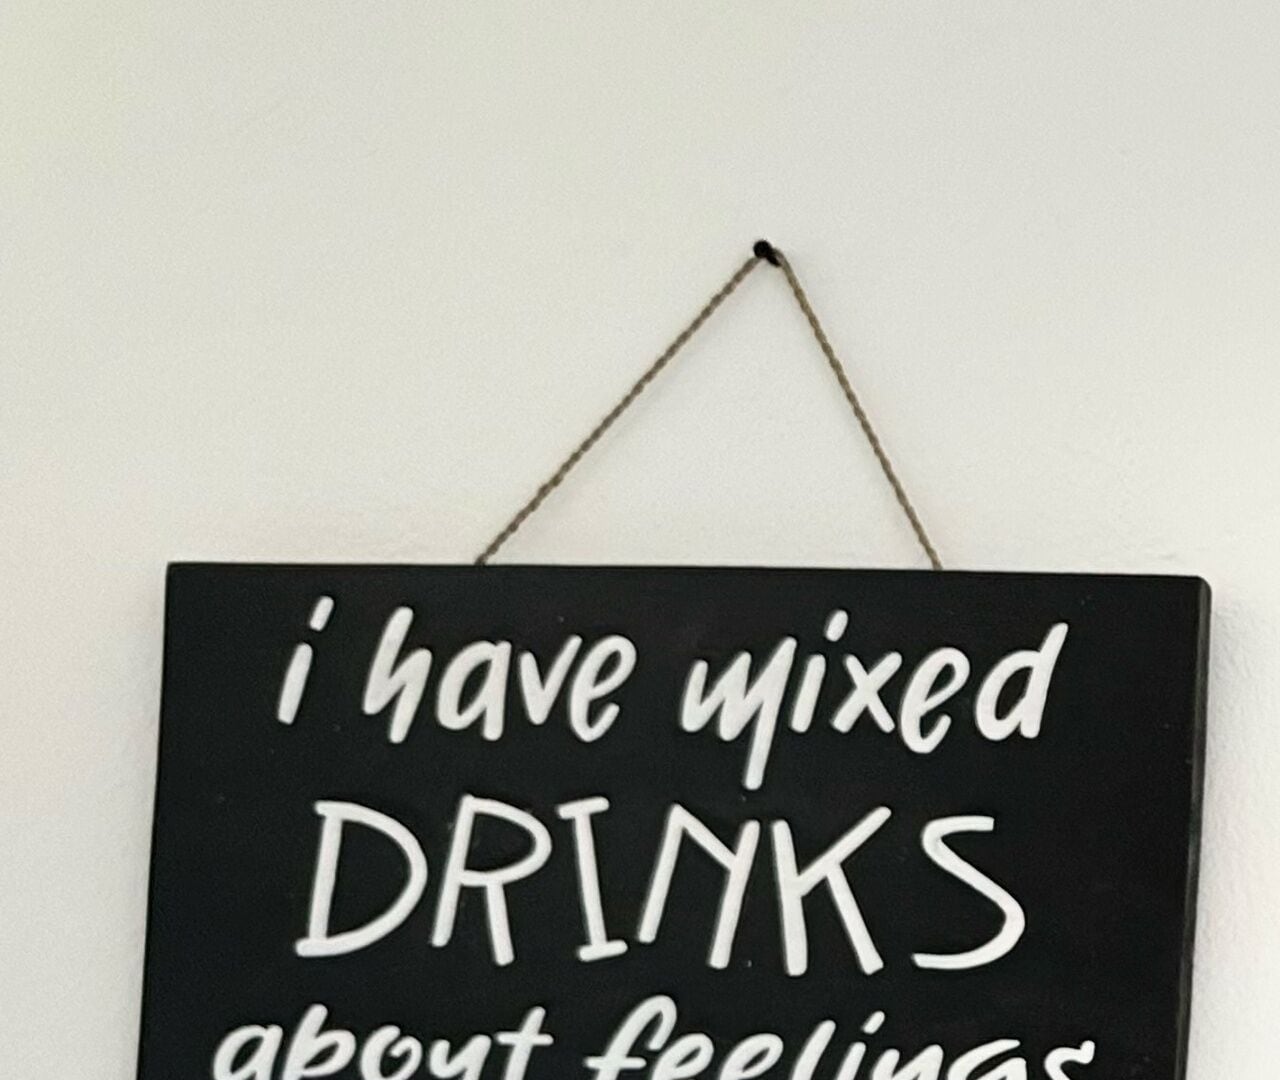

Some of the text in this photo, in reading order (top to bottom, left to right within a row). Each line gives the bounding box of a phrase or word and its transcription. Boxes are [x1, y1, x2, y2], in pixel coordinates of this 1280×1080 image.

[277, 595, 1070, 791] i have mixed
[294, 793, 1027, 977] DRINKS
